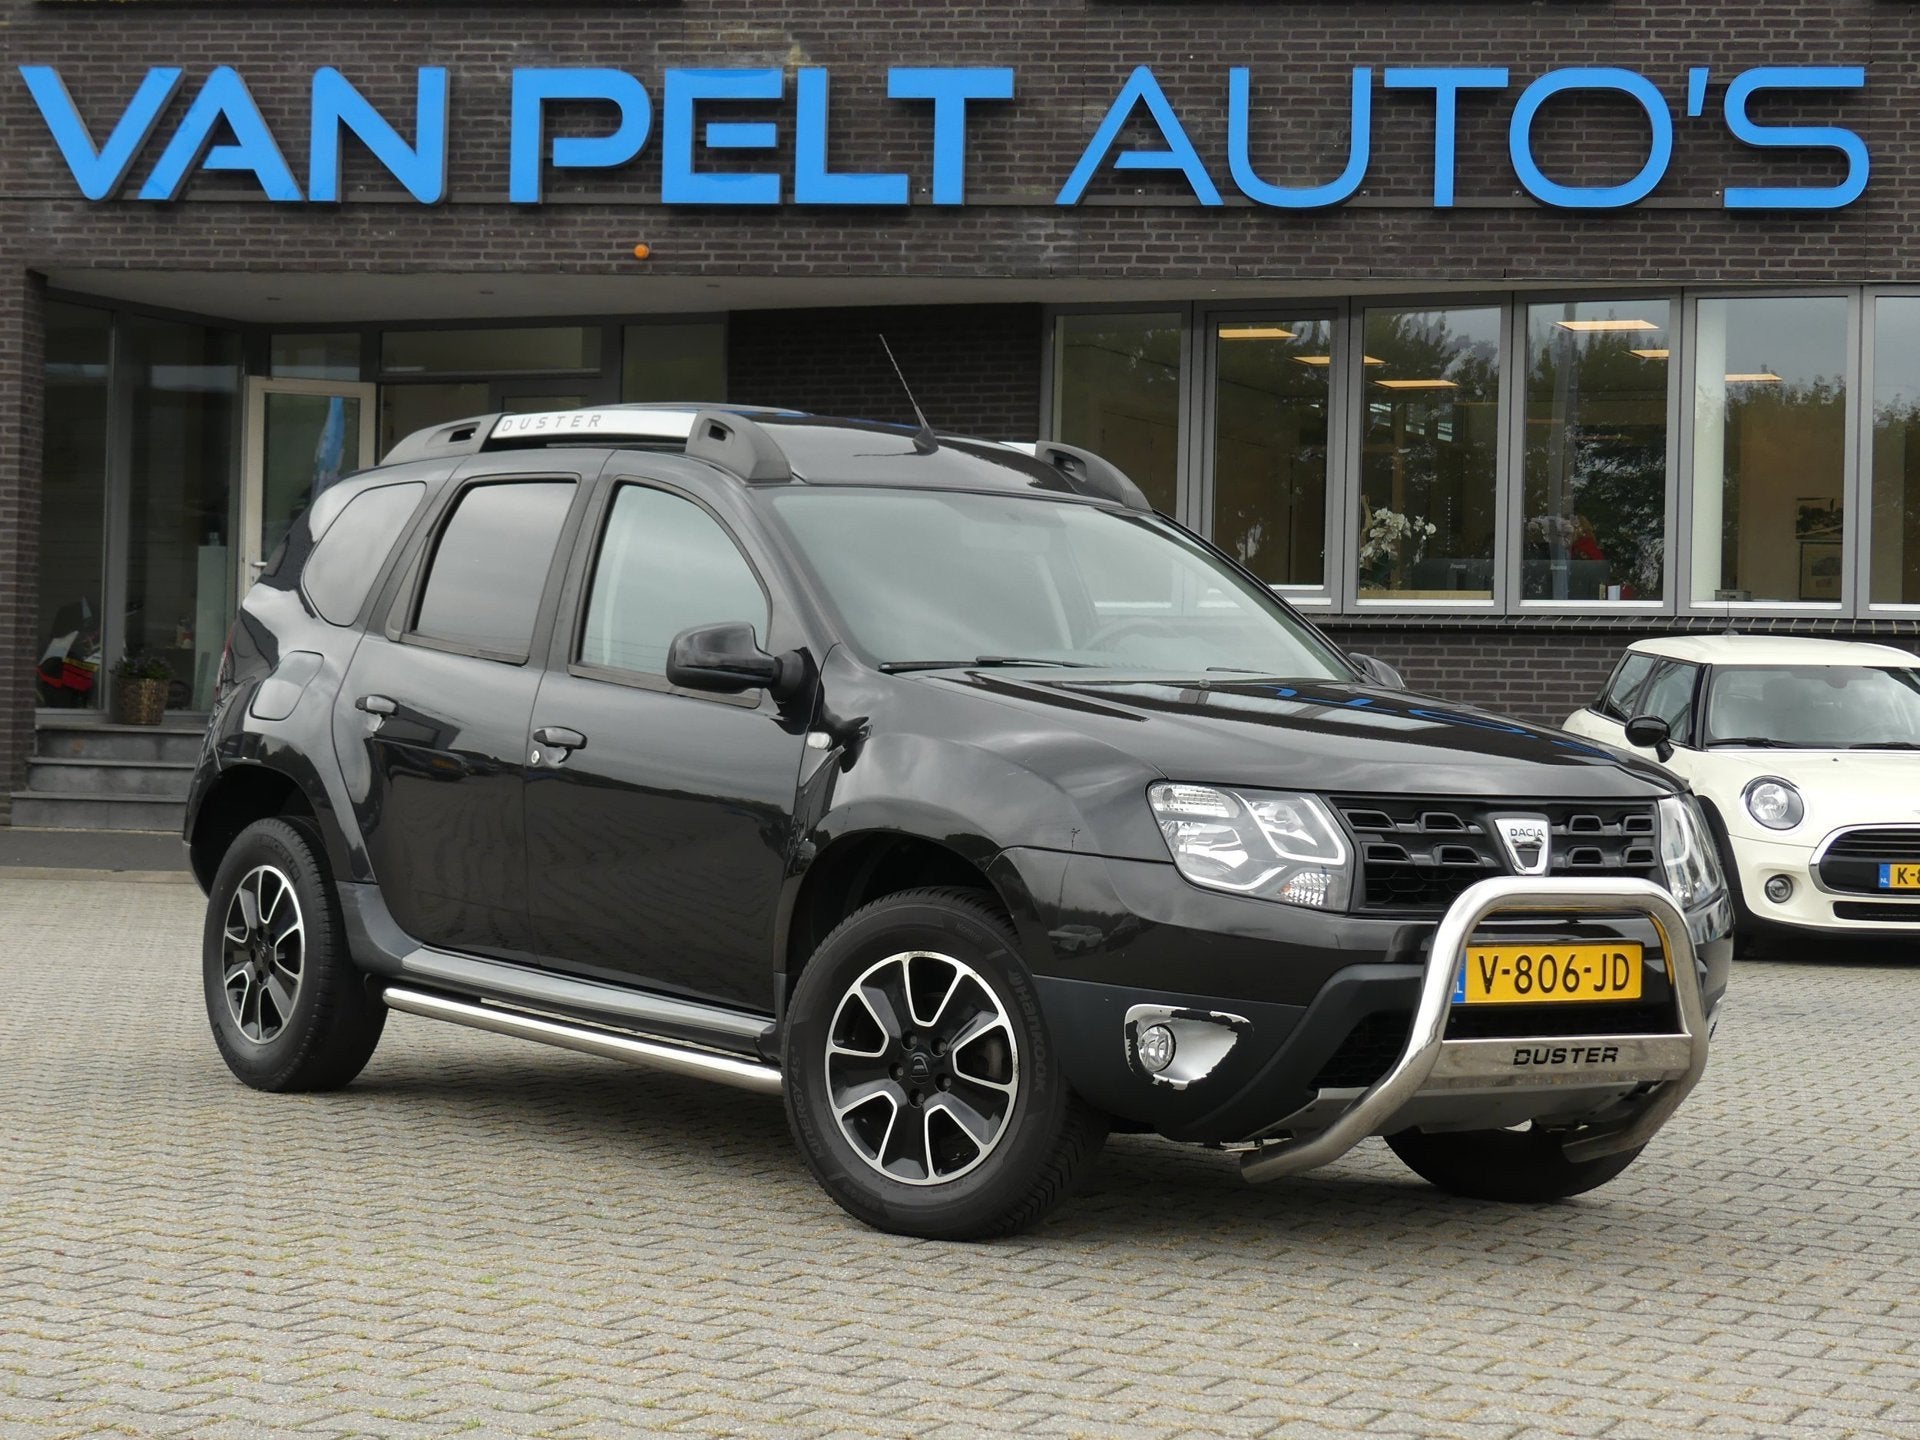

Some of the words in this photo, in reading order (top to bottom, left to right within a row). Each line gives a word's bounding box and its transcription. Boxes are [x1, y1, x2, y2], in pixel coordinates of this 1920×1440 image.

[20, 66, 445, 203] VAN
[510, 67, 1014, 205] PELT
[1057, 66, 1869, 208] AUTO'S
[502, 414, 602, 432] DUSTER
[1510, 828, 1544, 837] DACIA
[1478, 952, 1630, 994] V-806-JD
[1513, 1047, 1618, 1065] DUSTER
